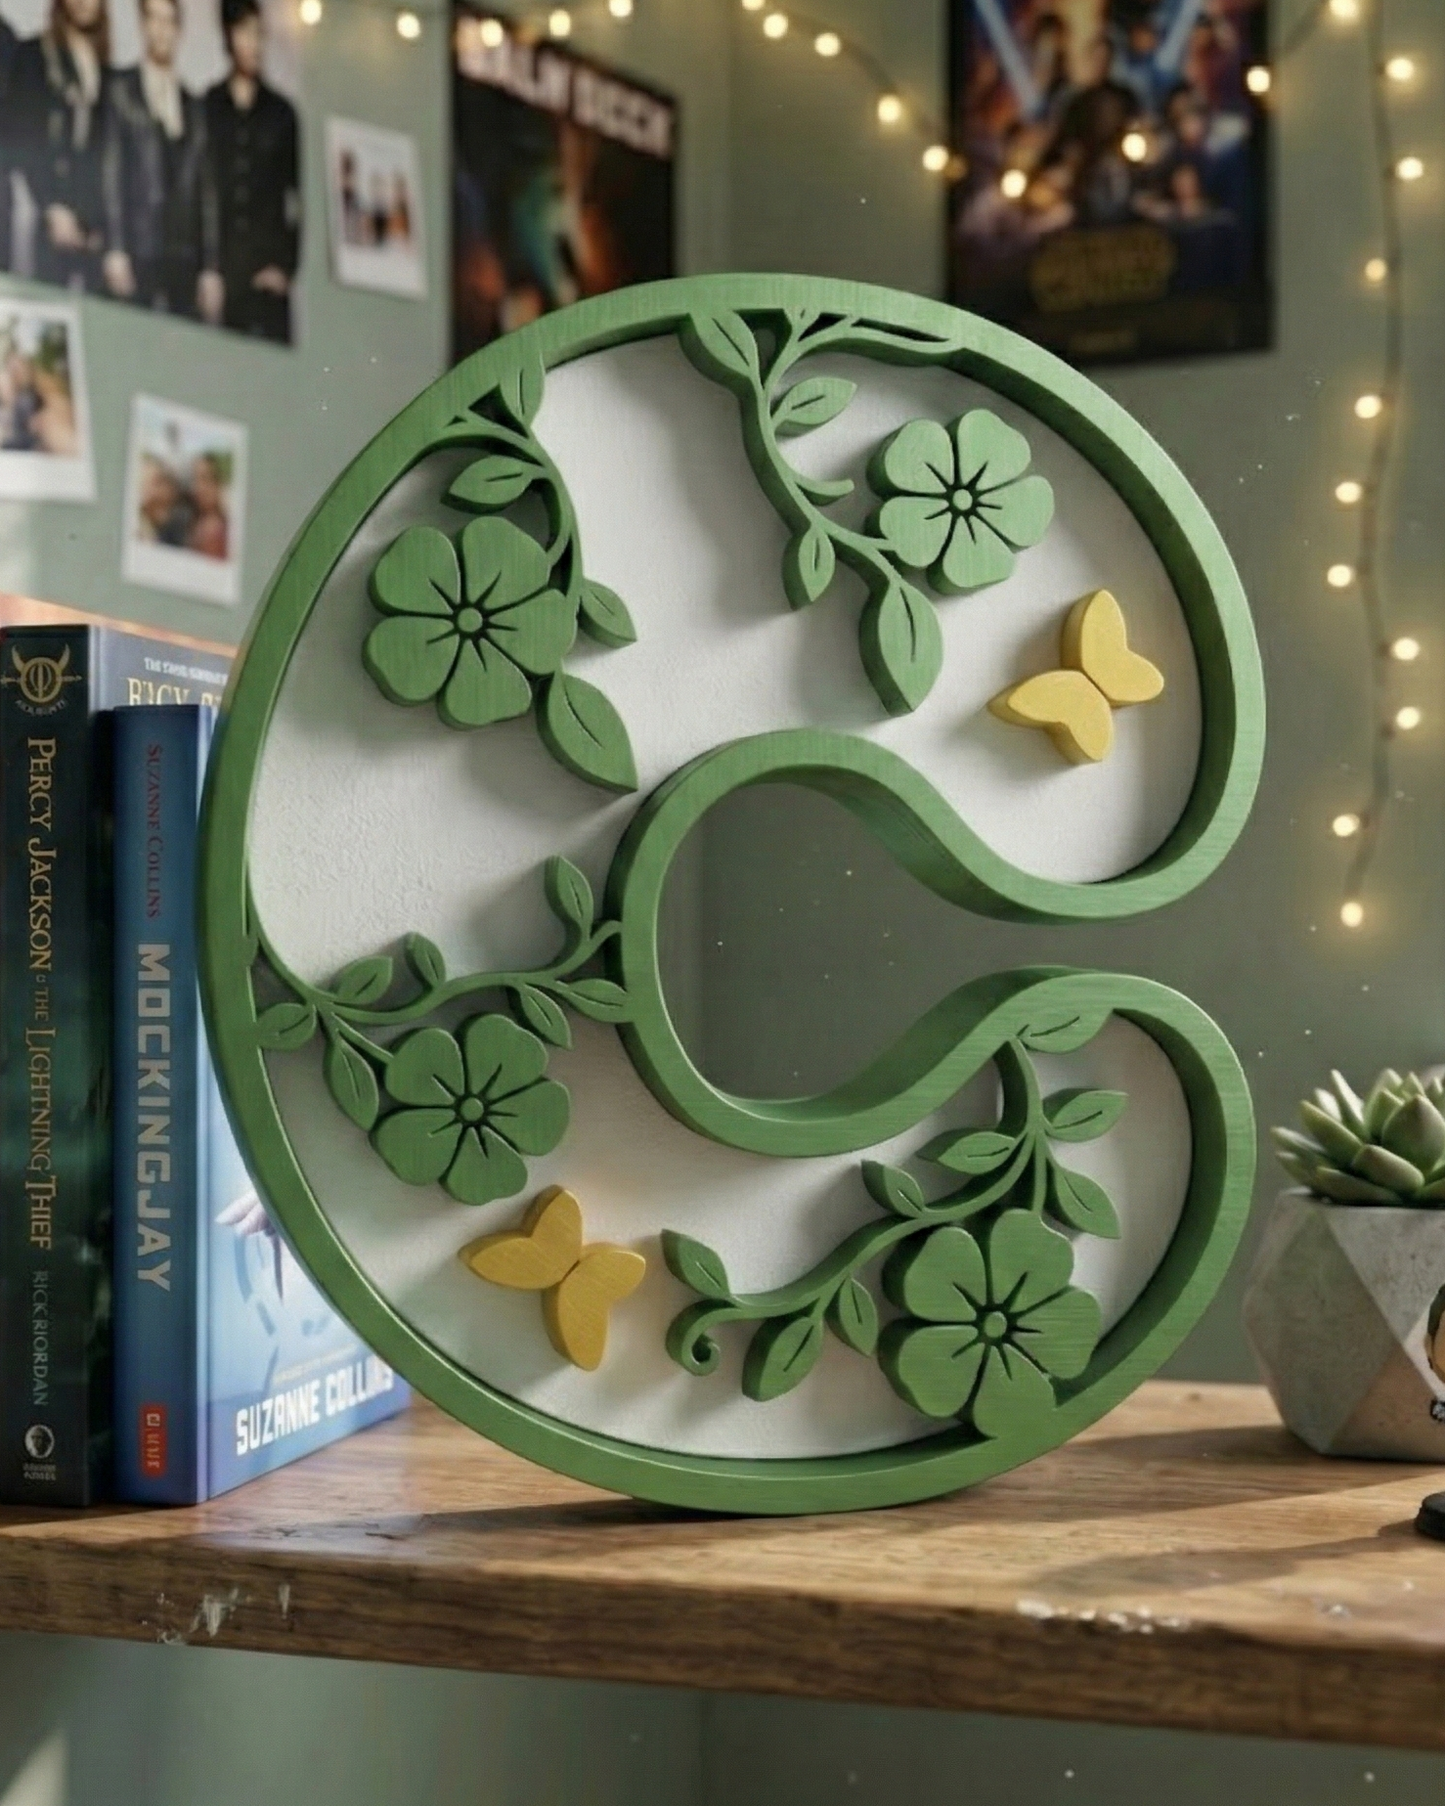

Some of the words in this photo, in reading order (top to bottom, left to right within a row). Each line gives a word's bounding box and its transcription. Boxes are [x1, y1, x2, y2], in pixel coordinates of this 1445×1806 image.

[27, 737, 57, 831] PERCY
[146, 744, 163, 832] SUZANNE
[27, 837, 57, 972] JACKSON
[146, 835, 163, 919] COLLINS
[35, 987, 49, 1022] THE
[25, 1027, 56, 1172] LIGHTNING
[137, 944, 171, 1292] MOCKINGJAY
[25, 1174, 57, 1251] THIEF
[32, 1319, 49, 1406] RIORDAN
[236, 1379, 321, 1457] SUZANNE
